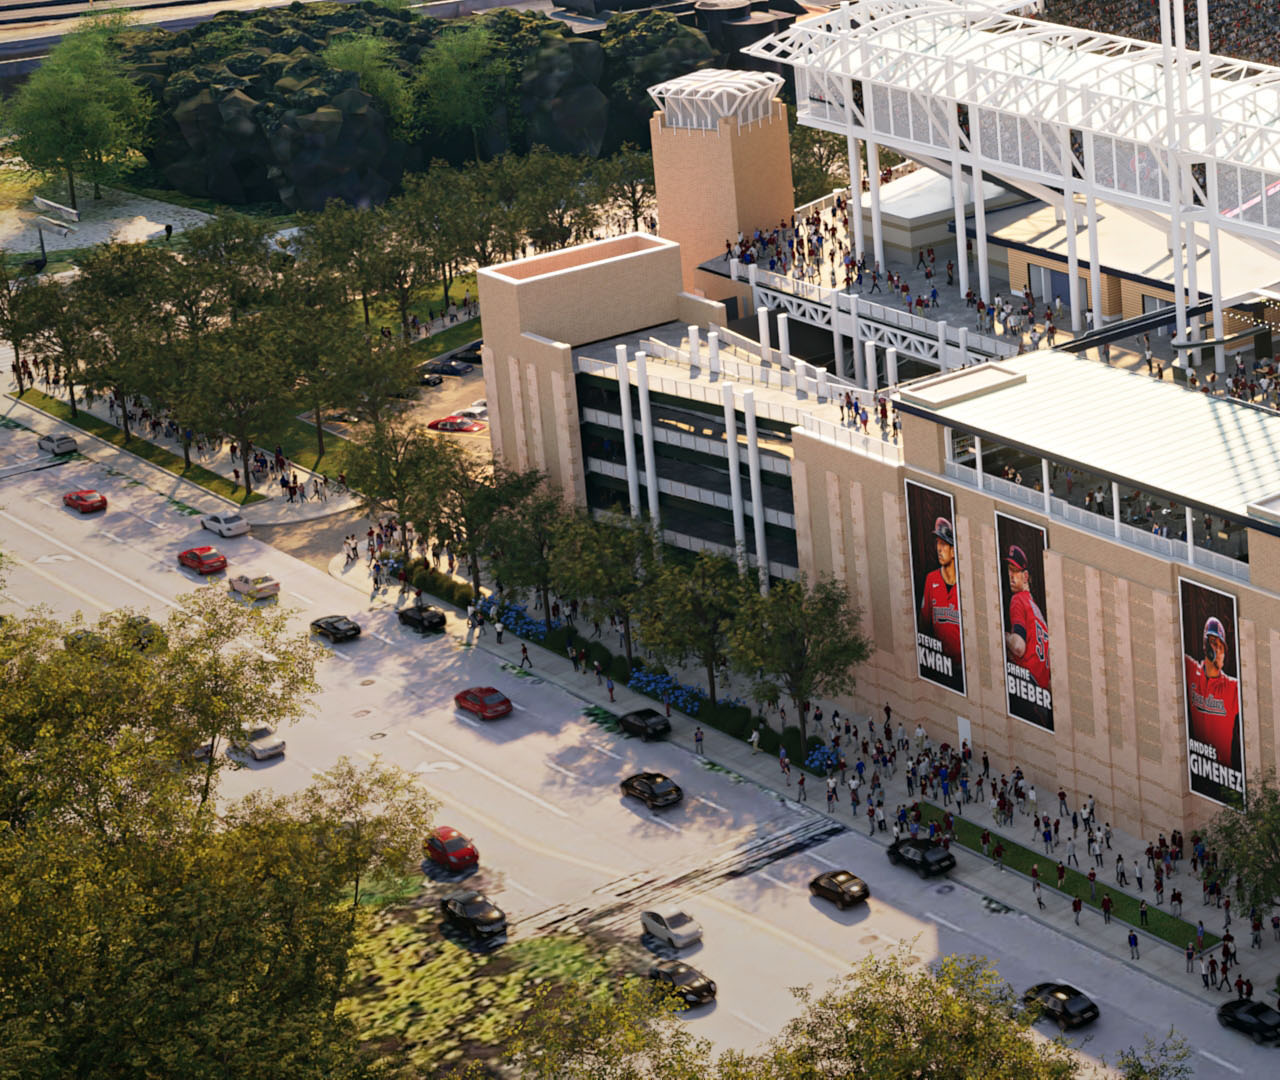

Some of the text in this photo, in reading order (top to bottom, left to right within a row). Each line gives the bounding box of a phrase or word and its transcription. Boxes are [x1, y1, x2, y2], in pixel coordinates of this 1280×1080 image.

[917, 633, 943, 653] STEVEN
[919, 645, 953, 677] KWAN
[1007, 662, 1031, 681] SHANE
[1008, 675, 1052, 710] BIEBER
[1190, 753, 1243, 793] GIMENEZ
